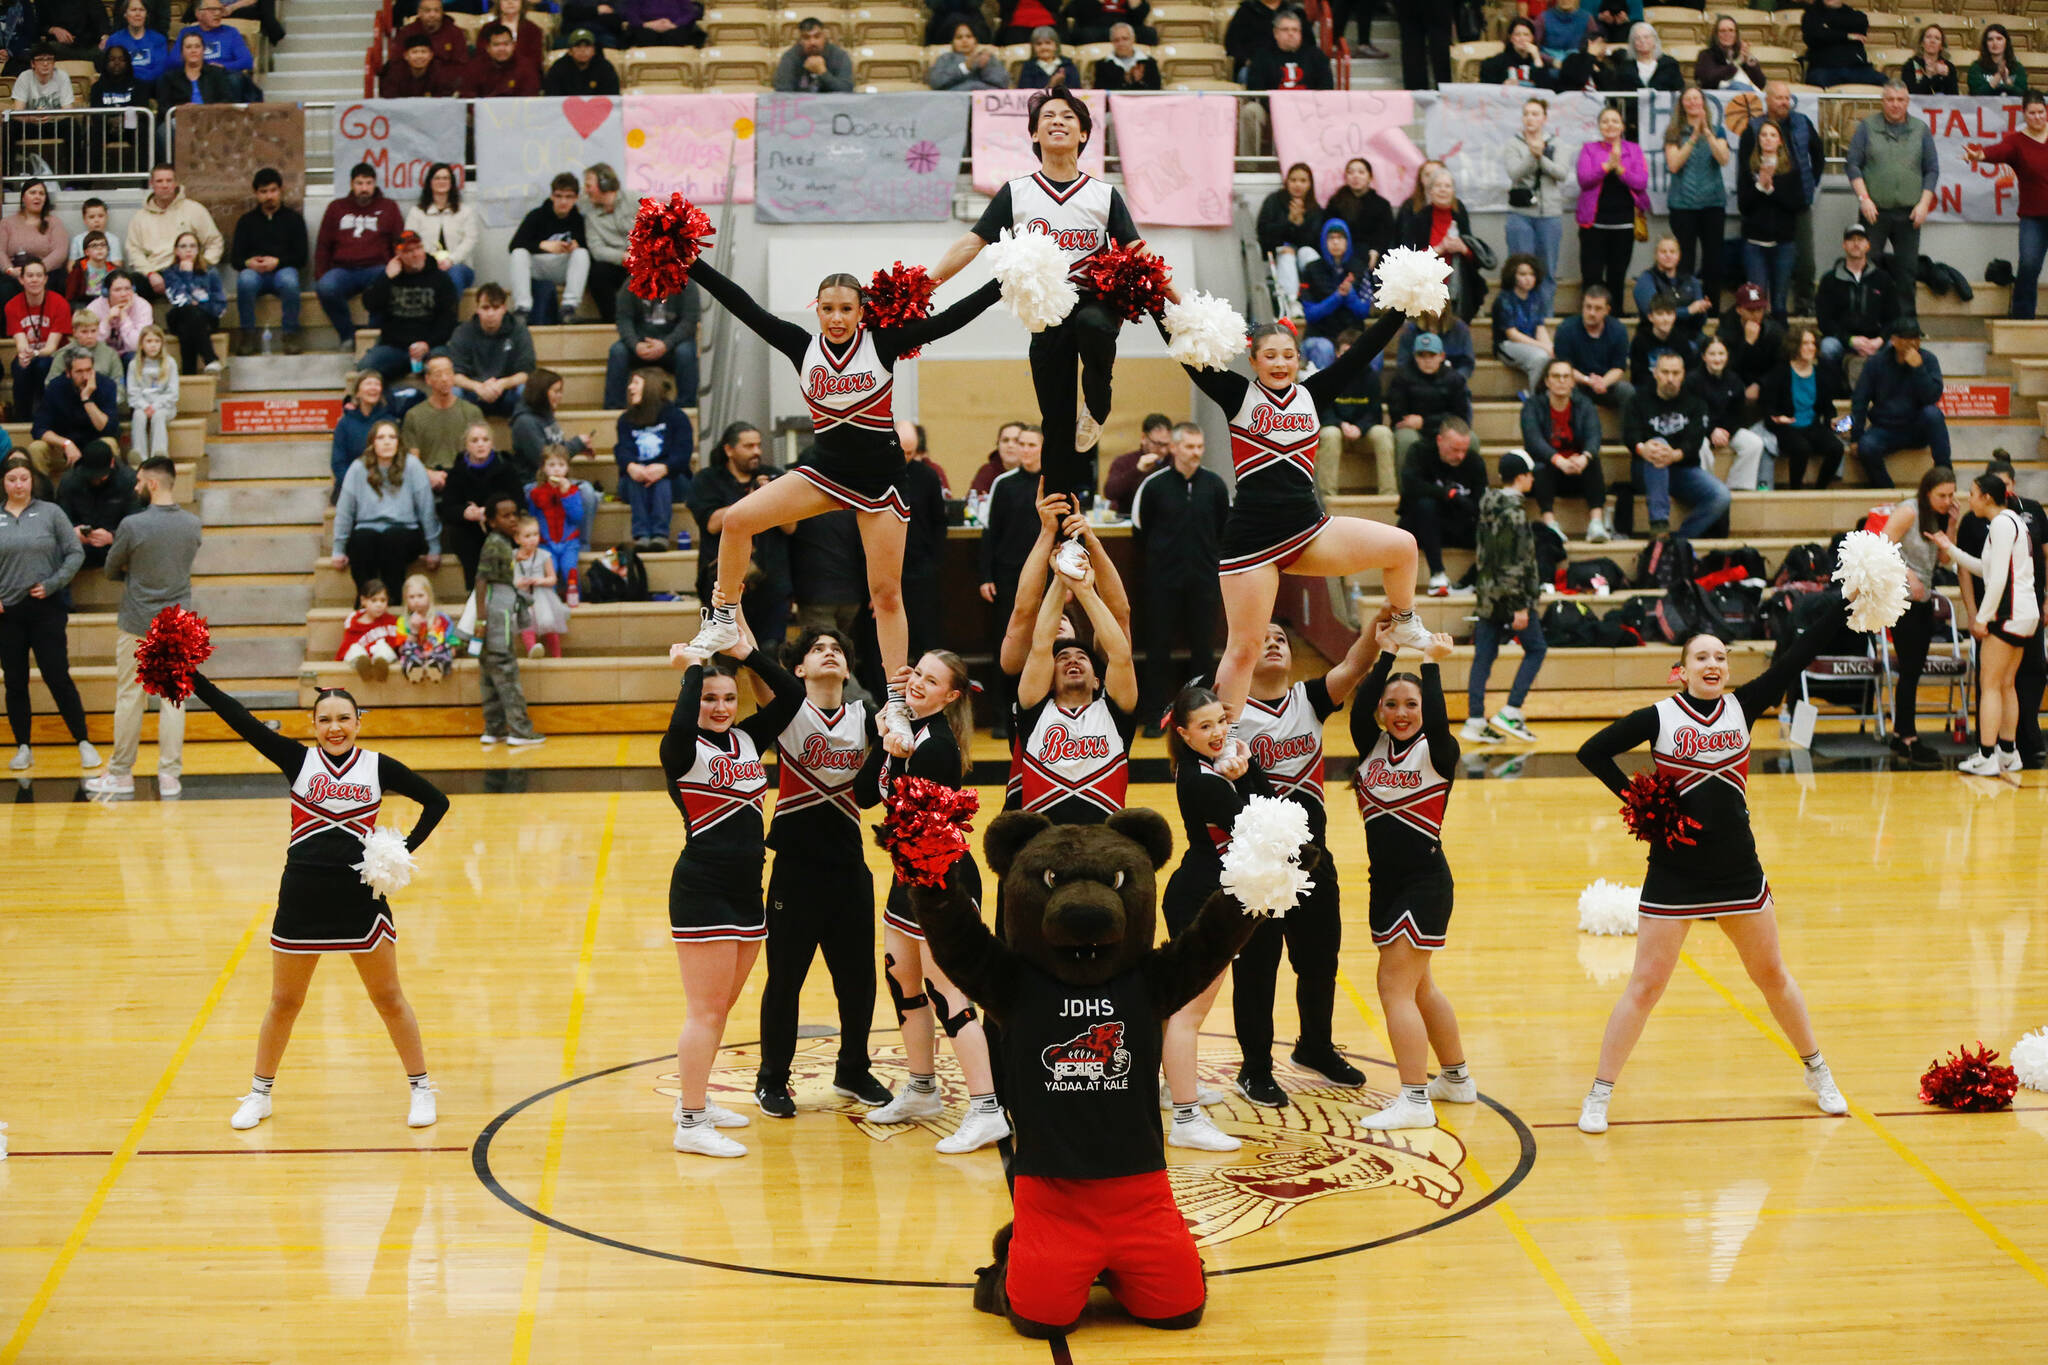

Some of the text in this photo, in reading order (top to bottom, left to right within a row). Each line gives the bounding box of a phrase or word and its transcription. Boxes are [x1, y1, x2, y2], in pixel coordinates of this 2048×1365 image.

[340, 104, 390, 140] Go
[1320, 121, 1363, 157] GO
[808, 365, 876, 400] Bears
[1248, 403, 1314, 436] Bears
[1833, 662, 1874, 674] KINGS
[799, 733, 864, 769] Bears
[1040, 724, 1109, 764] Bears
[1250, 732, 1317, 771] Bears
[1673, 725, 1743, 759] Bears
[305, 772, 372, 803] Bears
[709, 755, 767, 789] Bear
[1362, 758, 1421, 789] Bears
[1059, 999, 1114, 1017] JDHS
[1054, 1062, 1104, 1081] BEARS
[1103, 1077, 1128, 1091] KALÉ
